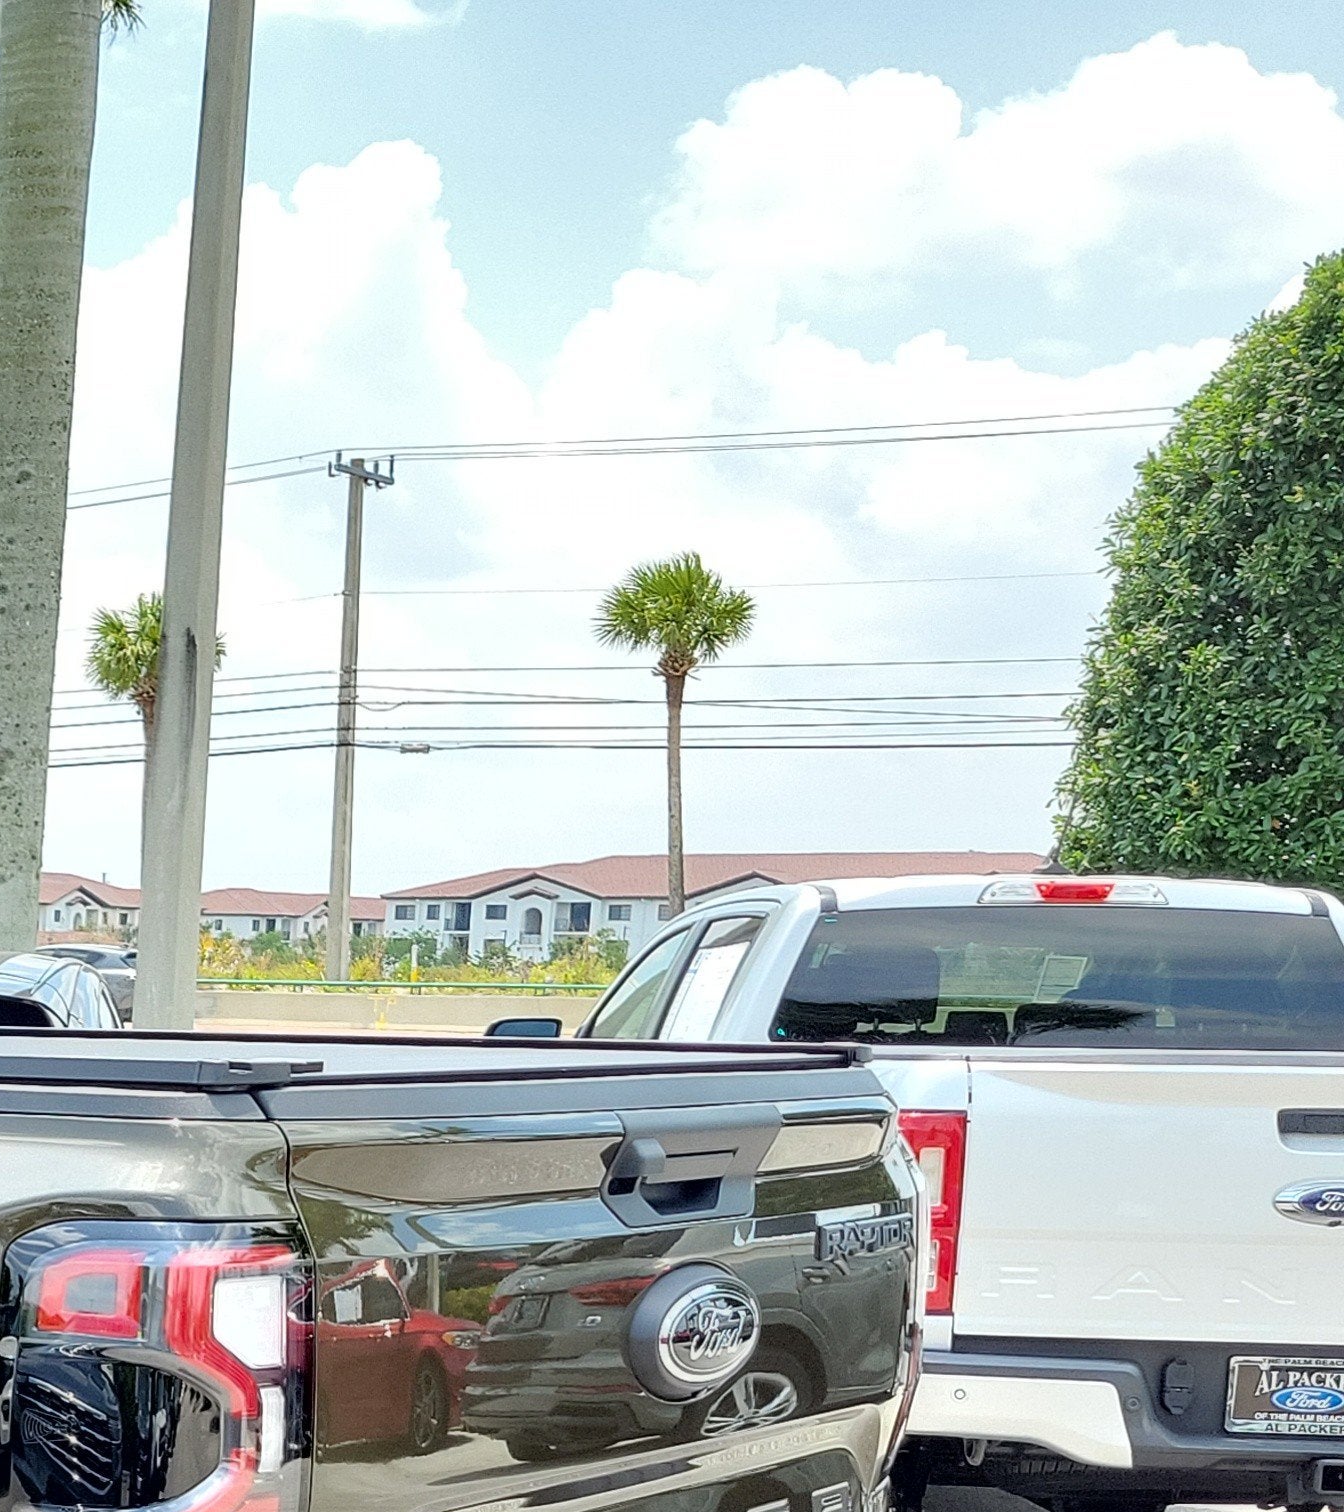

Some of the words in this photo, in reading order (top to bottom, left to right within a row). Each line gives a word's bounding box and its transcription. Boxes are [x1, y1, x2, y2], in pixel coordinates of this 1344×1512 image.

[822, 1216, 915, 1262] RAPTOR
[690, 1305, 746, 1360] Ford
[1255, 1371, 1284, 1397] AL
[1285, 1391, 1332, 1409] Ford
[1254, 1412, 1268, 1420] OF
[1289, 1413, 1315, 1421] PALM
[1316, 1414, 1344, 1423] BEAC
[1265, 1423, 1282, 1432] AL
